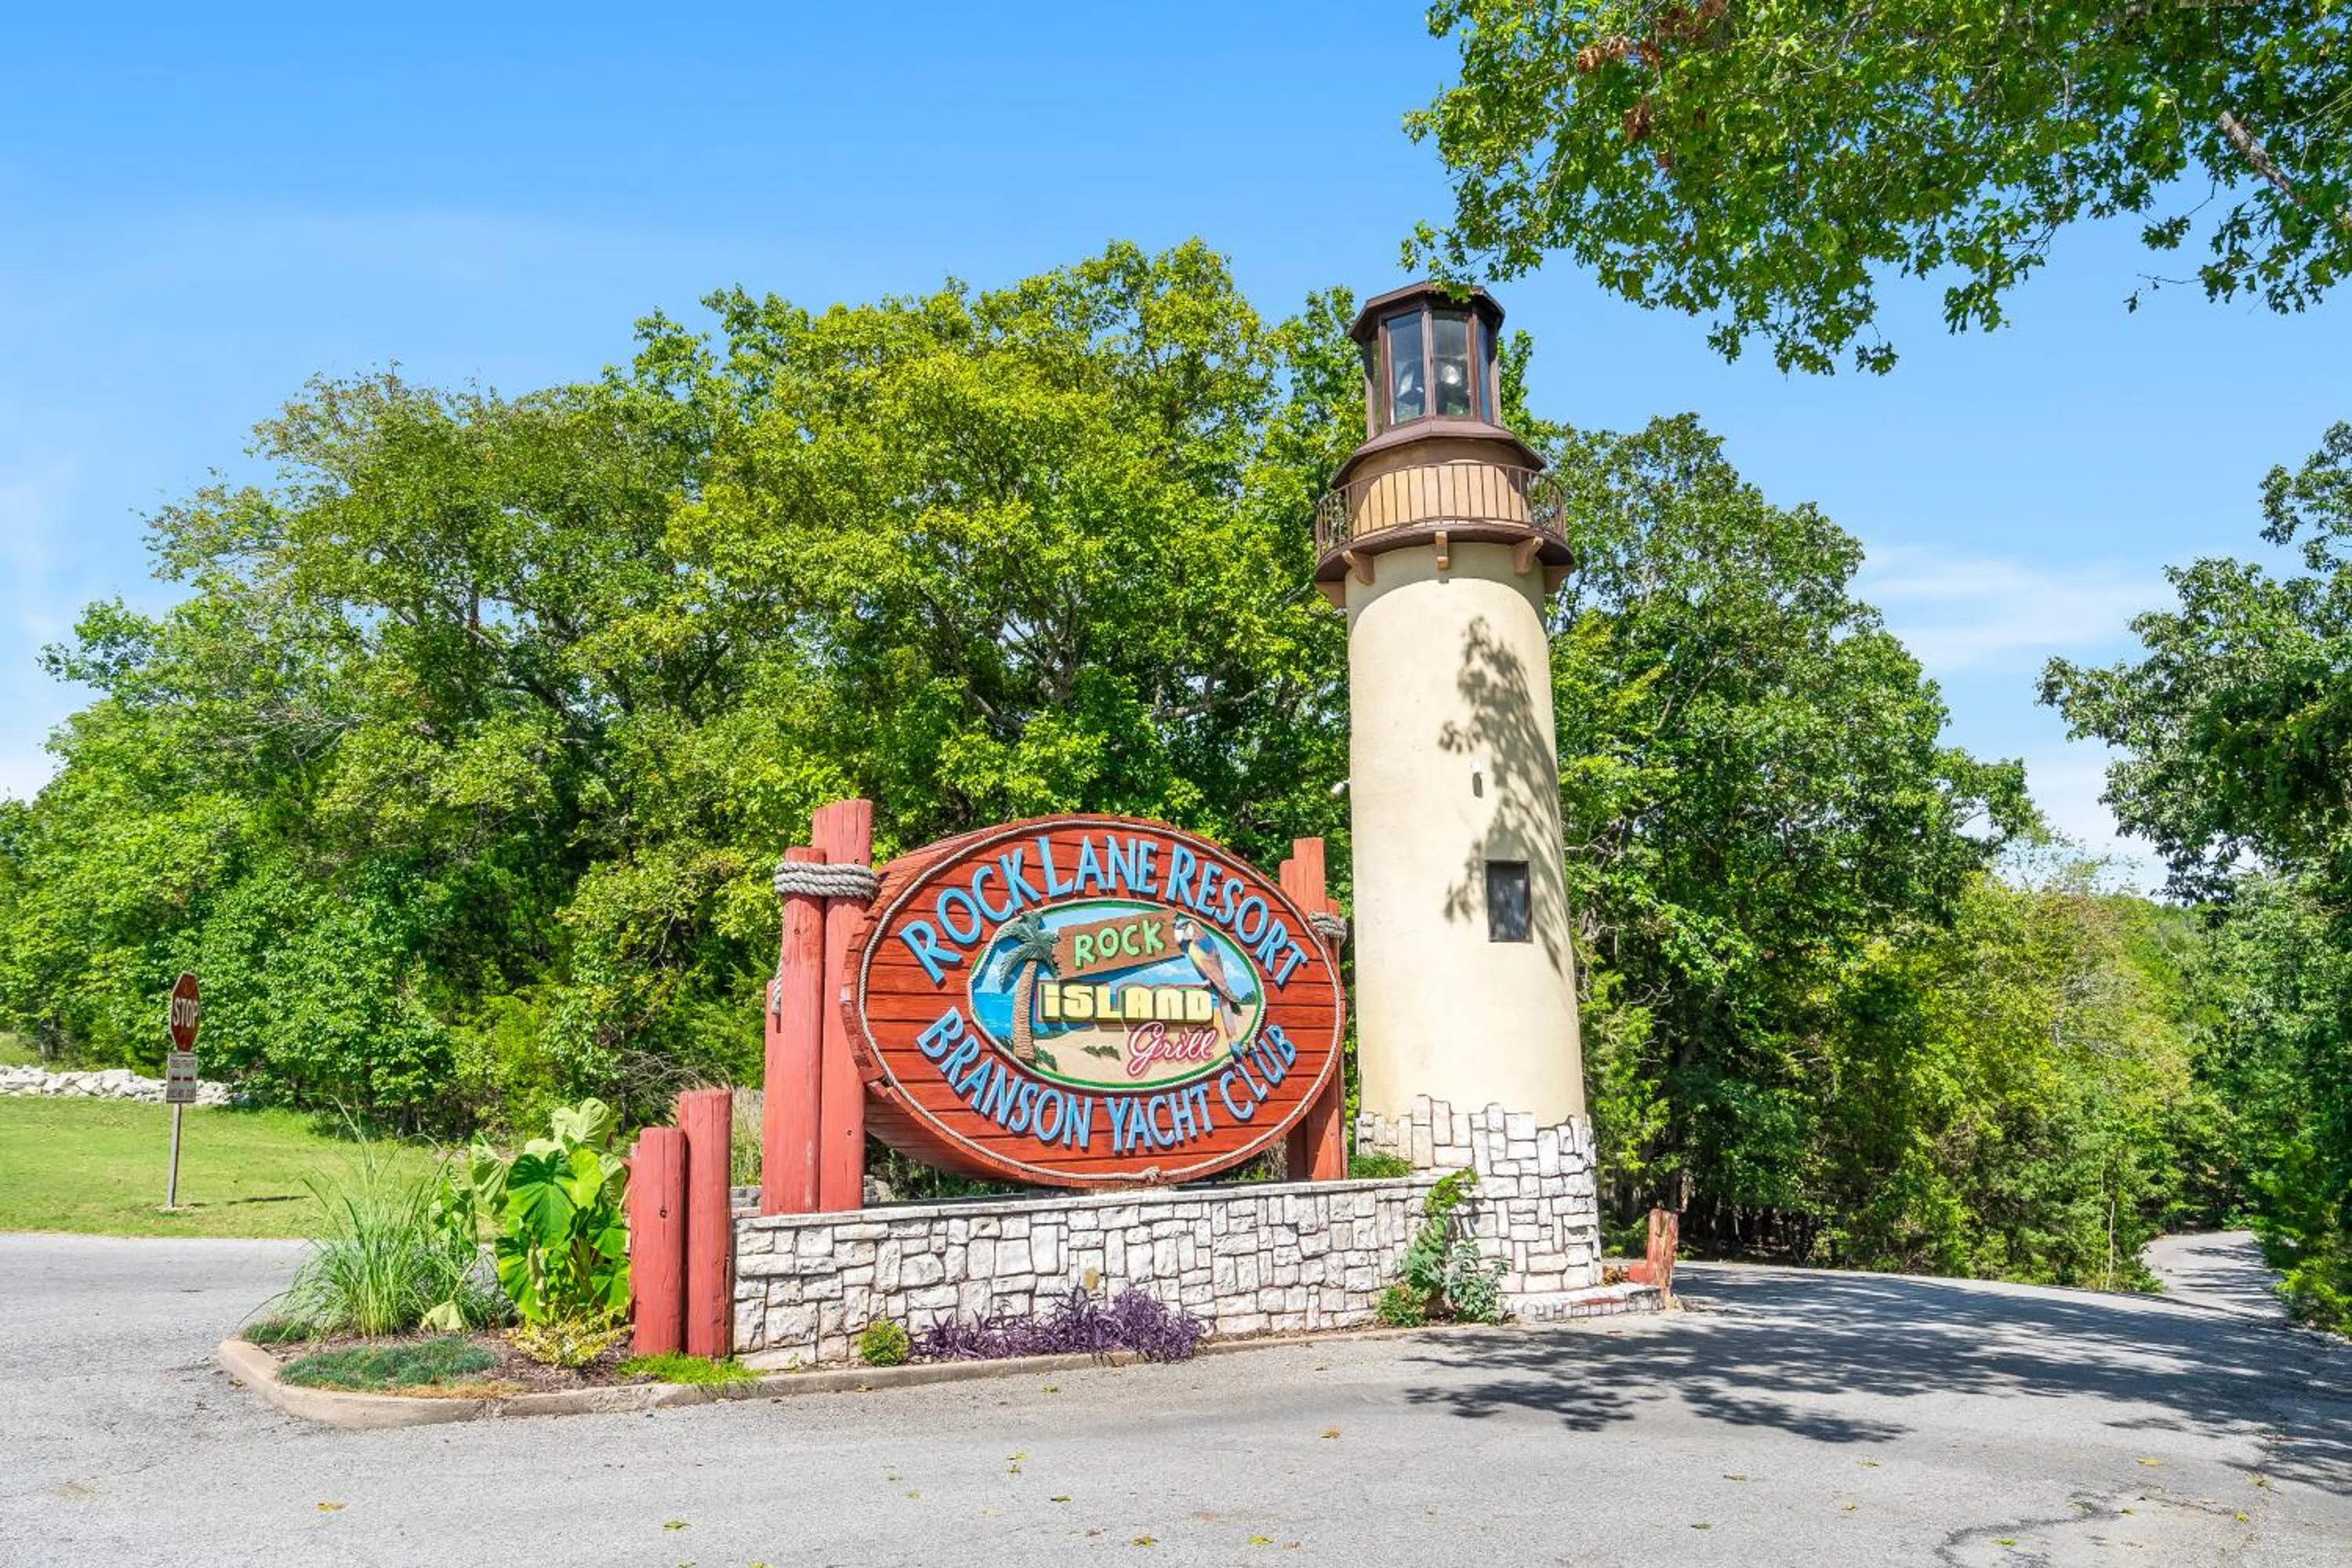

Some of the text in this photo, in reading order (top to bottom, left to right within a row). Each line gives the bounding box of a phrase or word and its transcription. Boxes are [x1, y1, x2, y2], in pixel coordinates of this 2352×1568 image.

[899, 836, 1308, 986] ROCK LANE RESORT
[1074, 919, 1166, 968] ROCK
[173, 997, 199, 1028] STOP
[1127, 1022, 1216, 1076] Grill
[916, 1006, 1297, 1153] BRANSON YACHT CLUB
